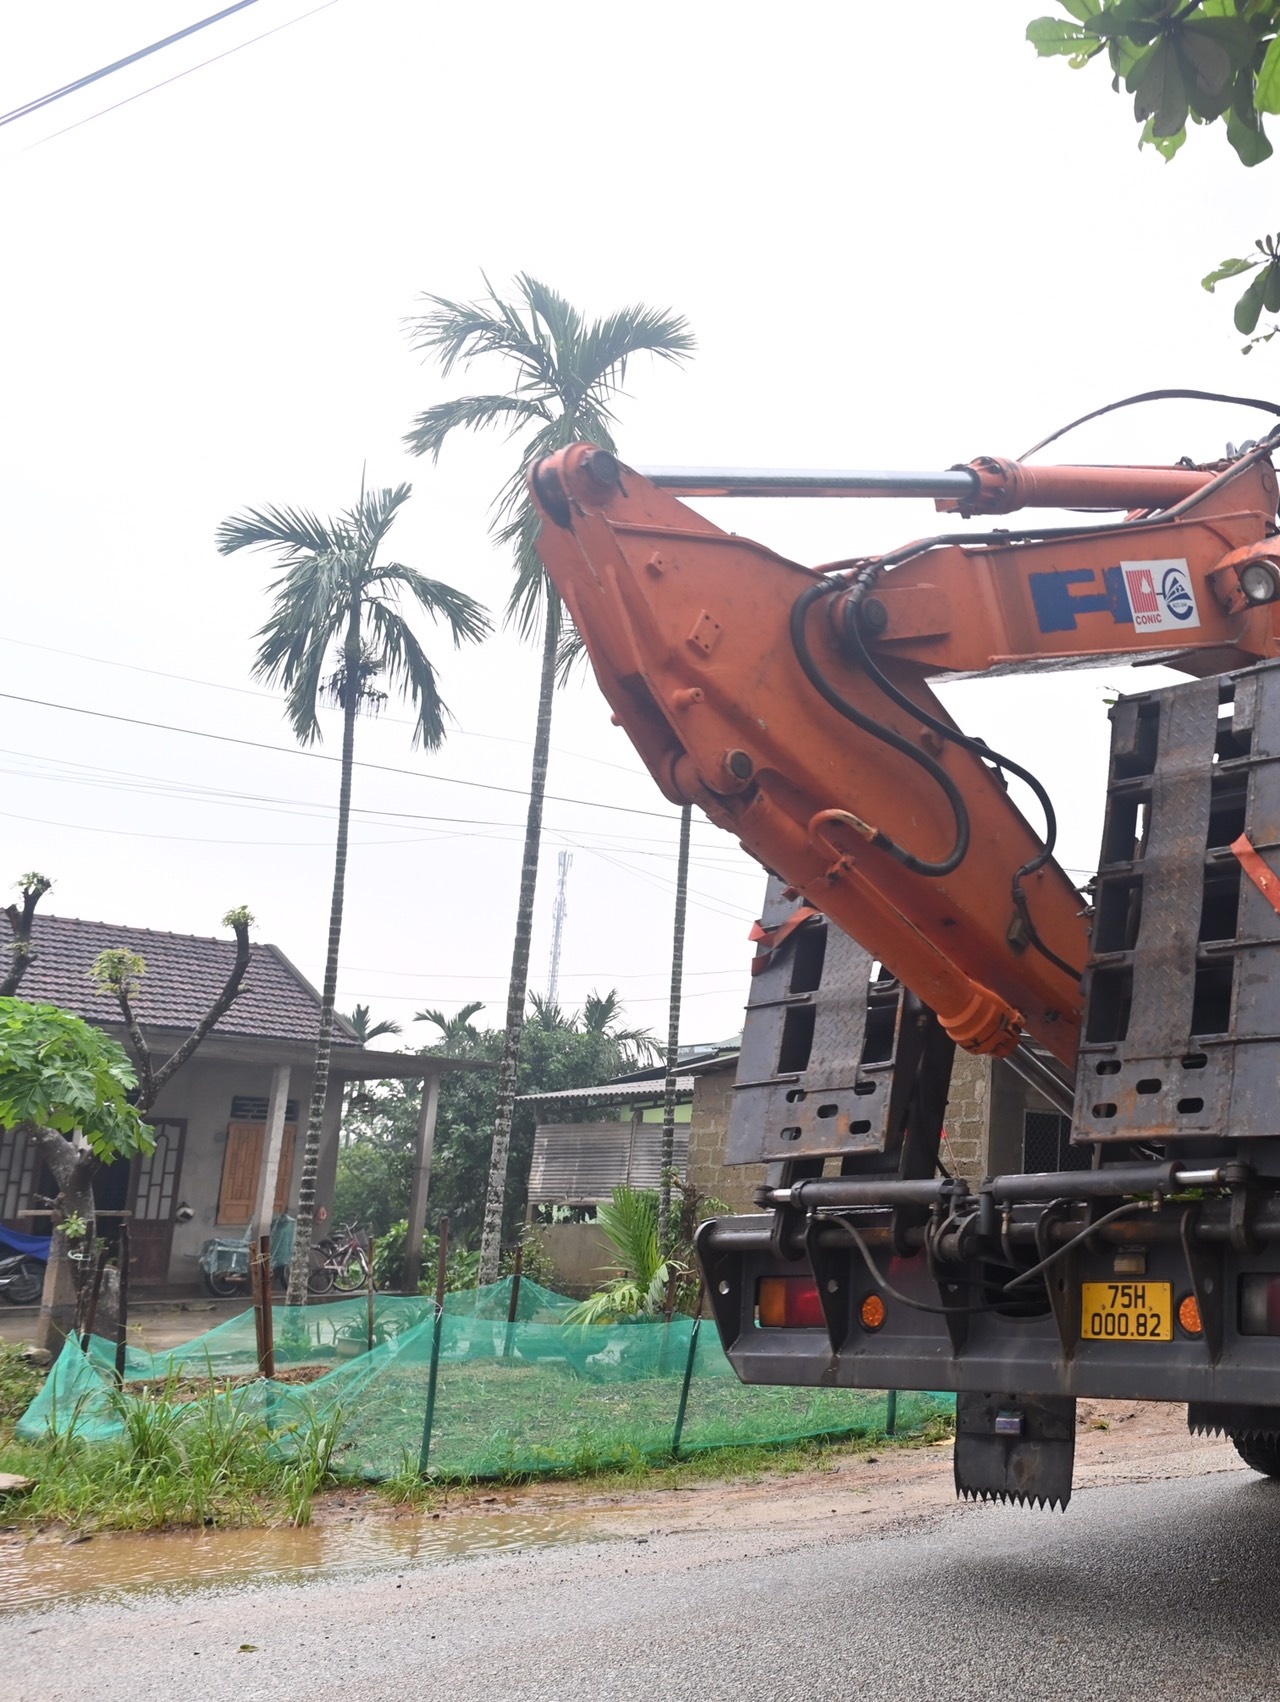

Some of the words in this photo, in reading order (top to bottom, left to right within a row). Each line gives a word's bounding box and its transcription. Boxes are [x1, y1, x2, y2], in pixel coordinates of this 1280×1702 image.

[1135, 613, 1162, 625] CONIC
[1107, 1285, 1146, 1309] 75H
[1091, 1312, 1161, 1337] 000.82
